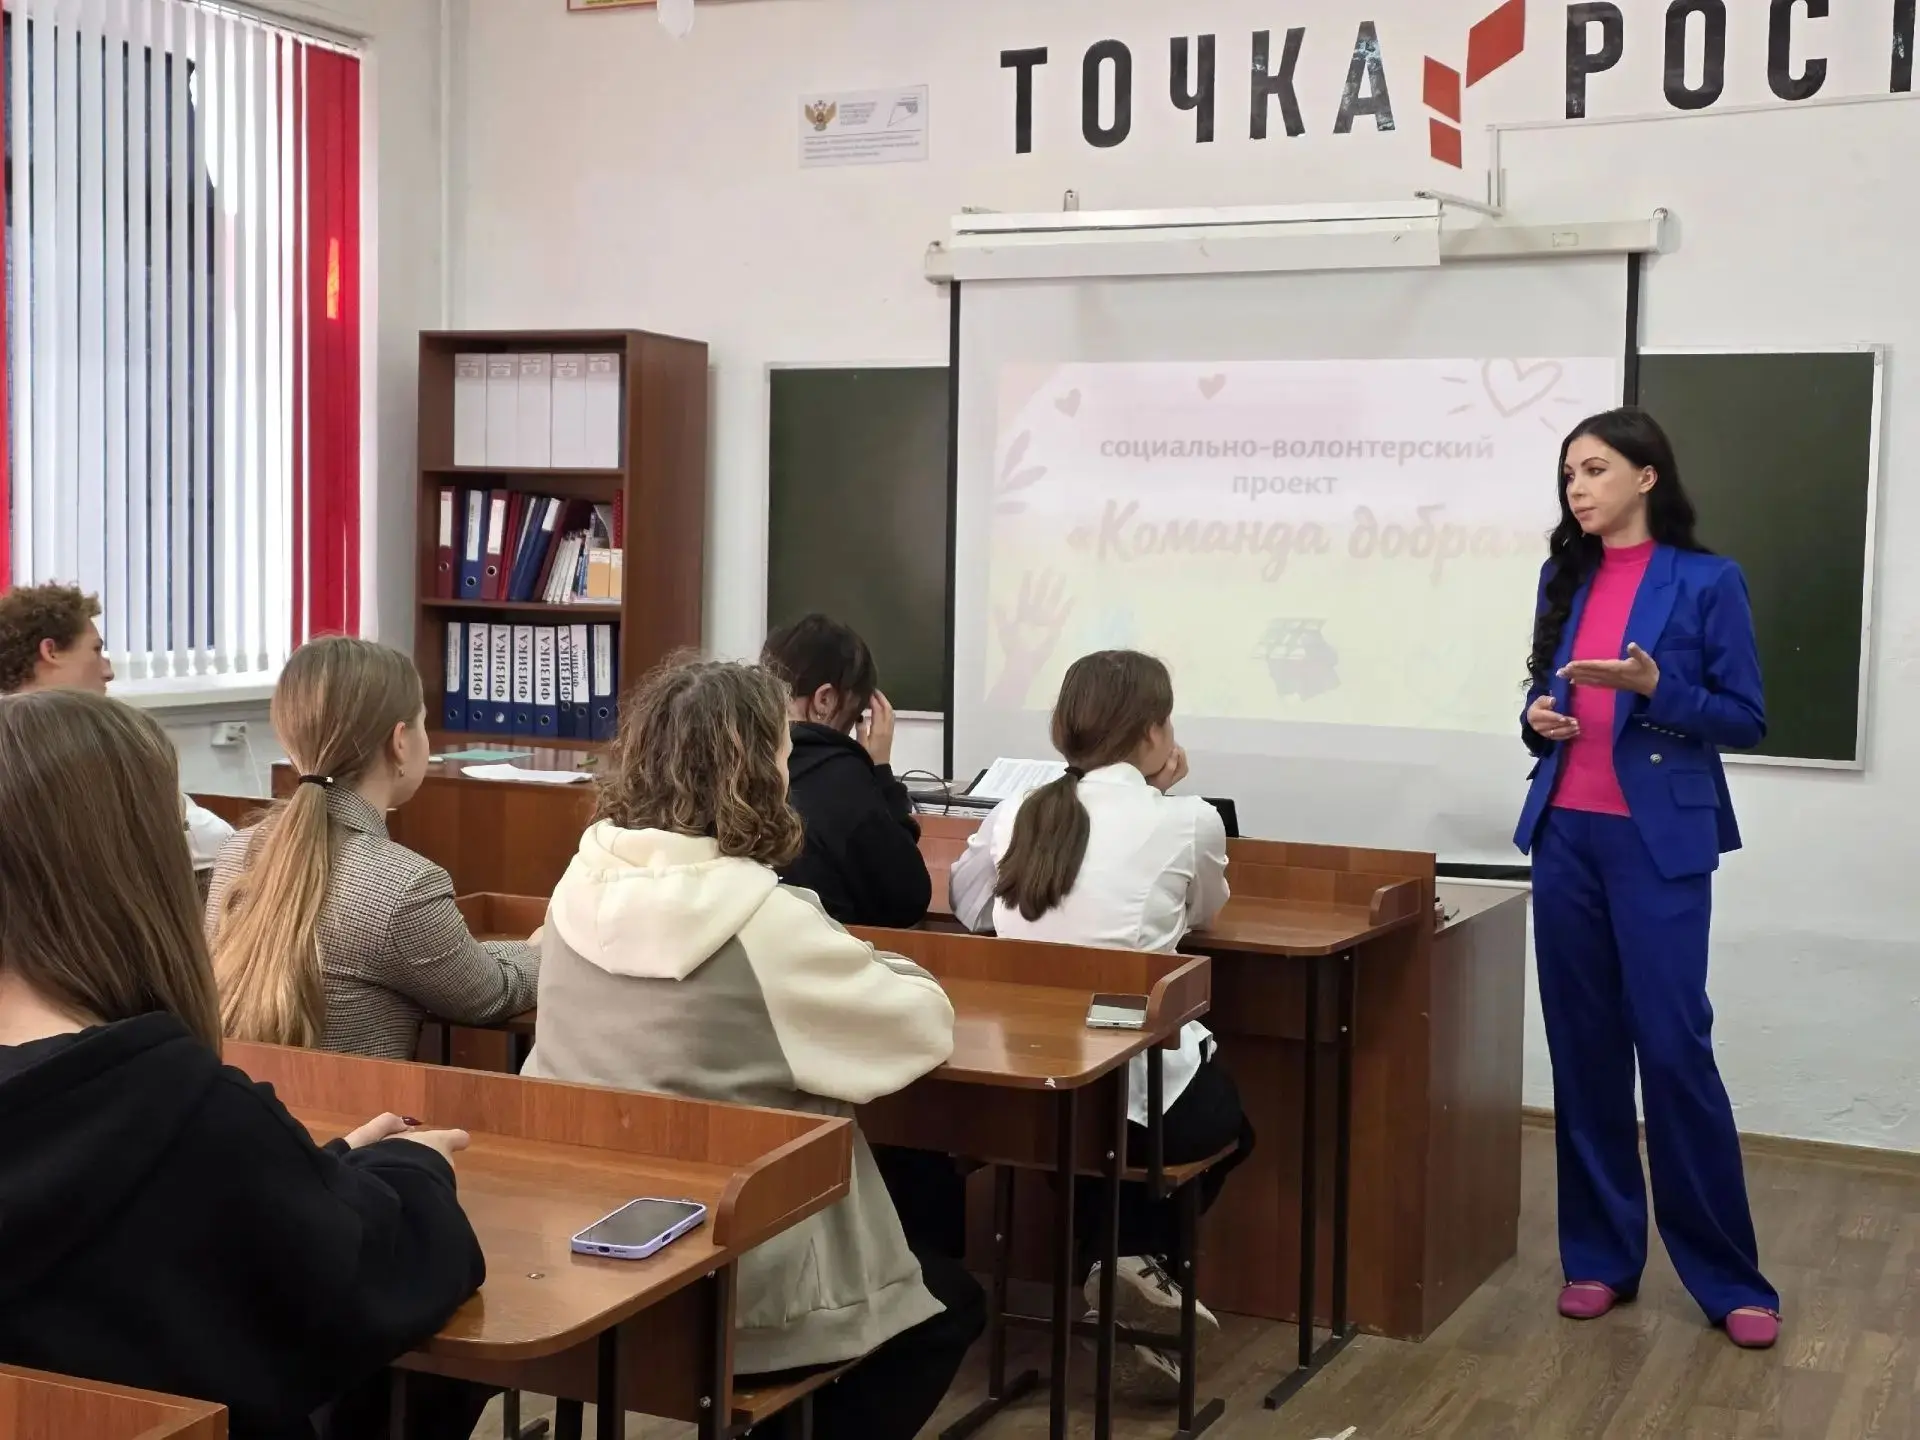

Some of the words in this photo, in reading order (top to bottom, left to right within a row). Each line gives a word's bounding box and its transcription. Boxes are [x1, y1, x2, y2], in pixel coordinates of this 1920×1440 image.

[1001, 20, 1396, 155] ТОЧКА
[1100, 435, 1494, 466] социально-волонтерский
[1232, 474, 1338, 502] проект
[473, 632, 484, 696] ФИЗИКА
[495, 633, 506, 698] ФИЗИКА
[518, 634, 528, 699] ФИЗИКА
[540, 636, 551, 700] ФИЗИКА
[560, 635, 571, 699] ФИЗИКА
